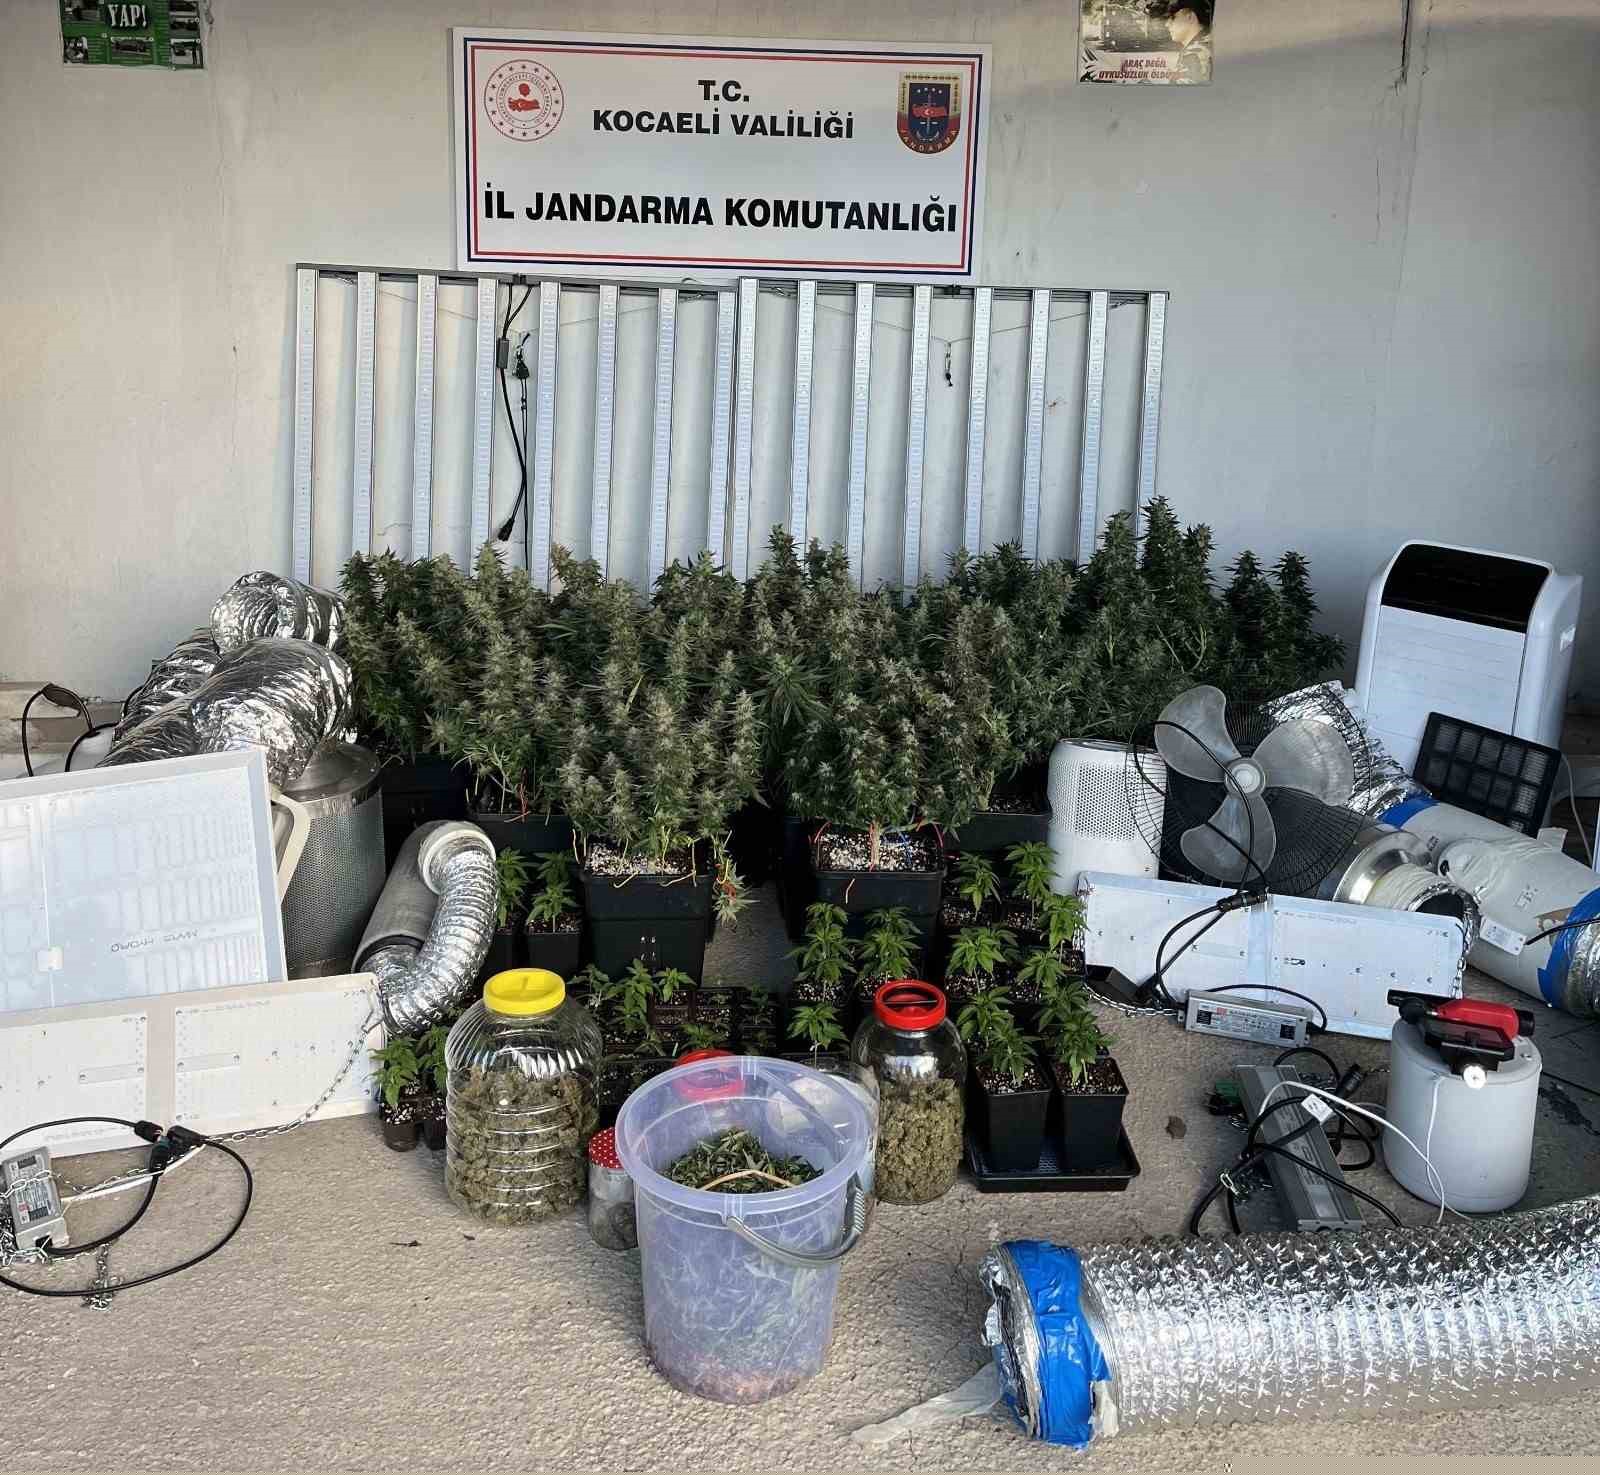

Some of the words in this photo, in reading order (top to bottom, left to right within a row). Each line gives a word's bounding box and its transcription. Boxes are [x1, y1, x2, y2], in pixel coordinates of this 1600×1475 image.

[107, 4, 147, 27] YAP!
[1098, 70, 1149, 80] UYKUSUZLUK
[1124, 59, 1144, 70] ARAÇ
[698, 79, 750, 103] T.C.
[593, 107, 720, 136] KOCAELİ
[731, 109, 854, 139] VALİLİĞİ
[484, 182, 515, 220] İL
[525, 191, 714, 226] JANDARMA
[725, 195, 957, 233] KOMUTANLIĞI
